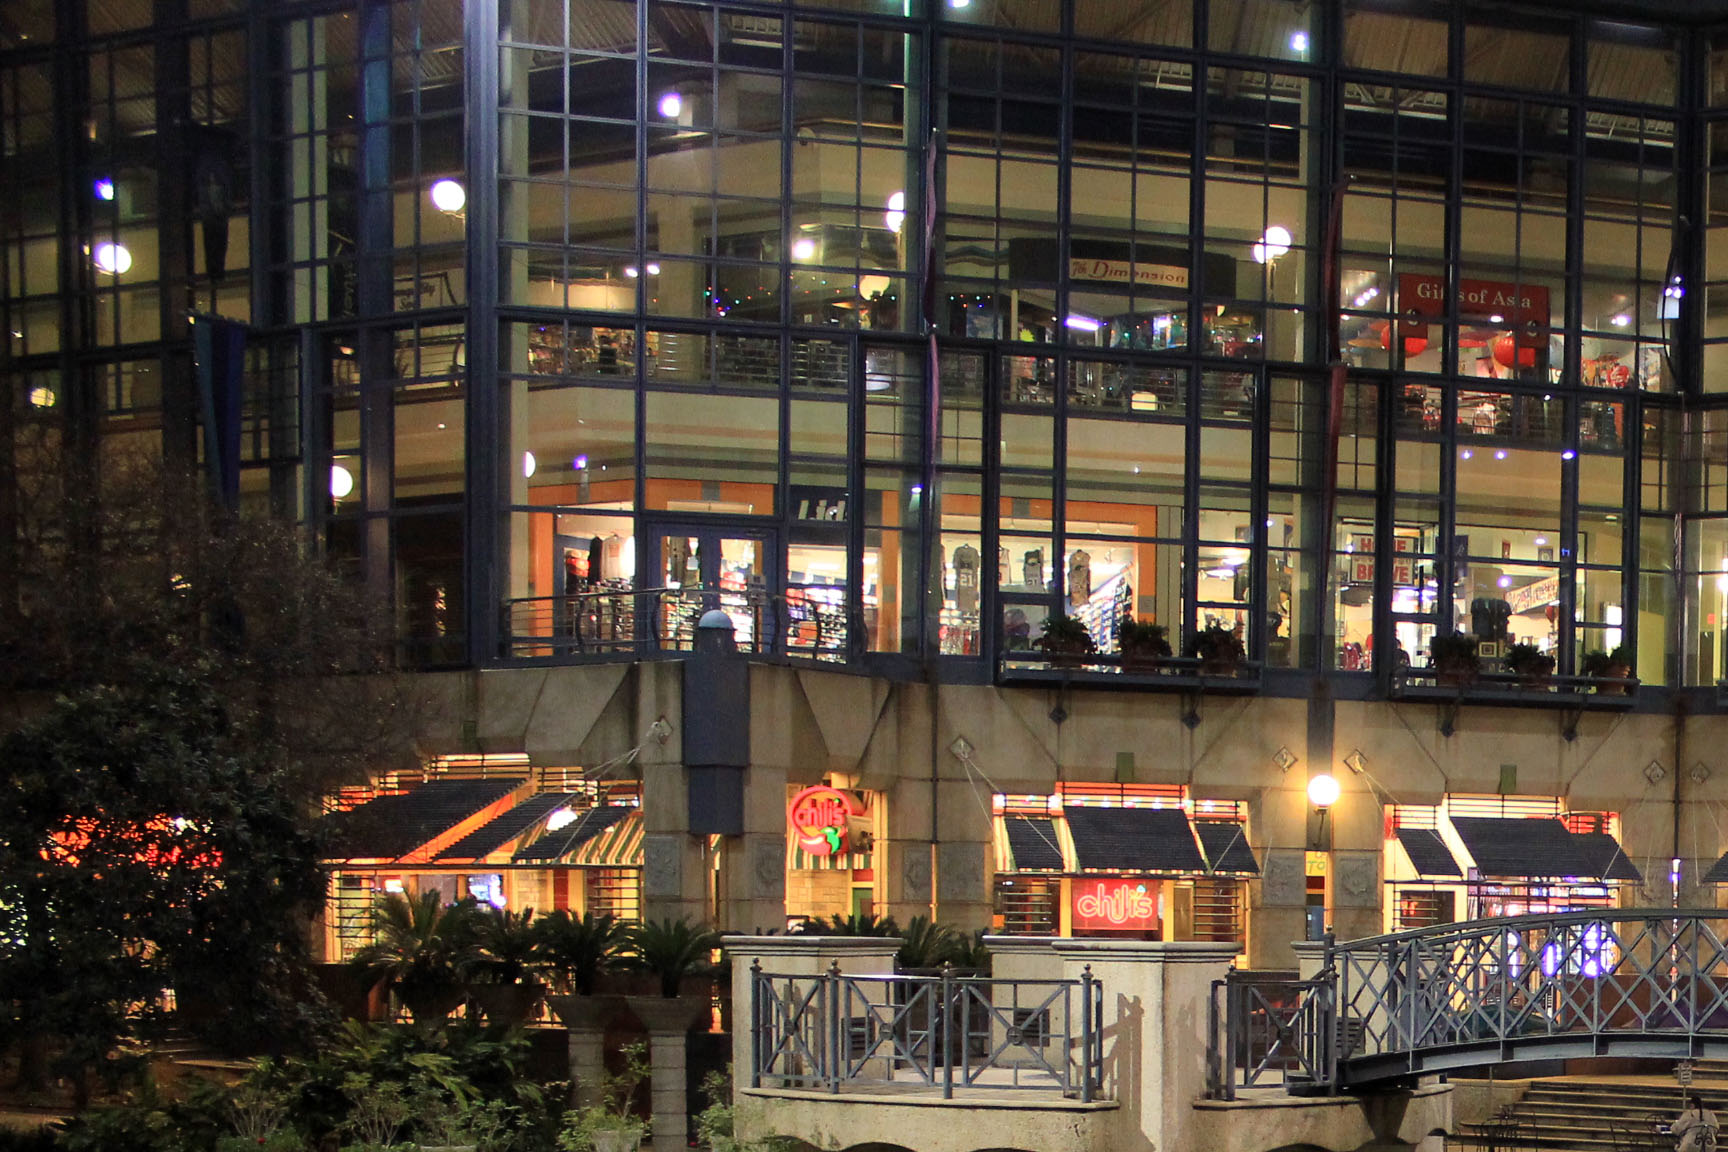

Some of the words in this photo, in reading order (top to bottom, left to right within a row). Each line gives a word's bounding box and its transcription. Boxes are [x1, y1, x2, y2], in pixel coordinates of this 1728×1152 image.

[1088, 261, 1184, 284] Dimnsion
[1468, 290, 1488, 304] of
[1492, 291, 1531, 309] Asa
[797, 499, 848, 521] Lid
[1077, 883, 1153, 924] chili's
